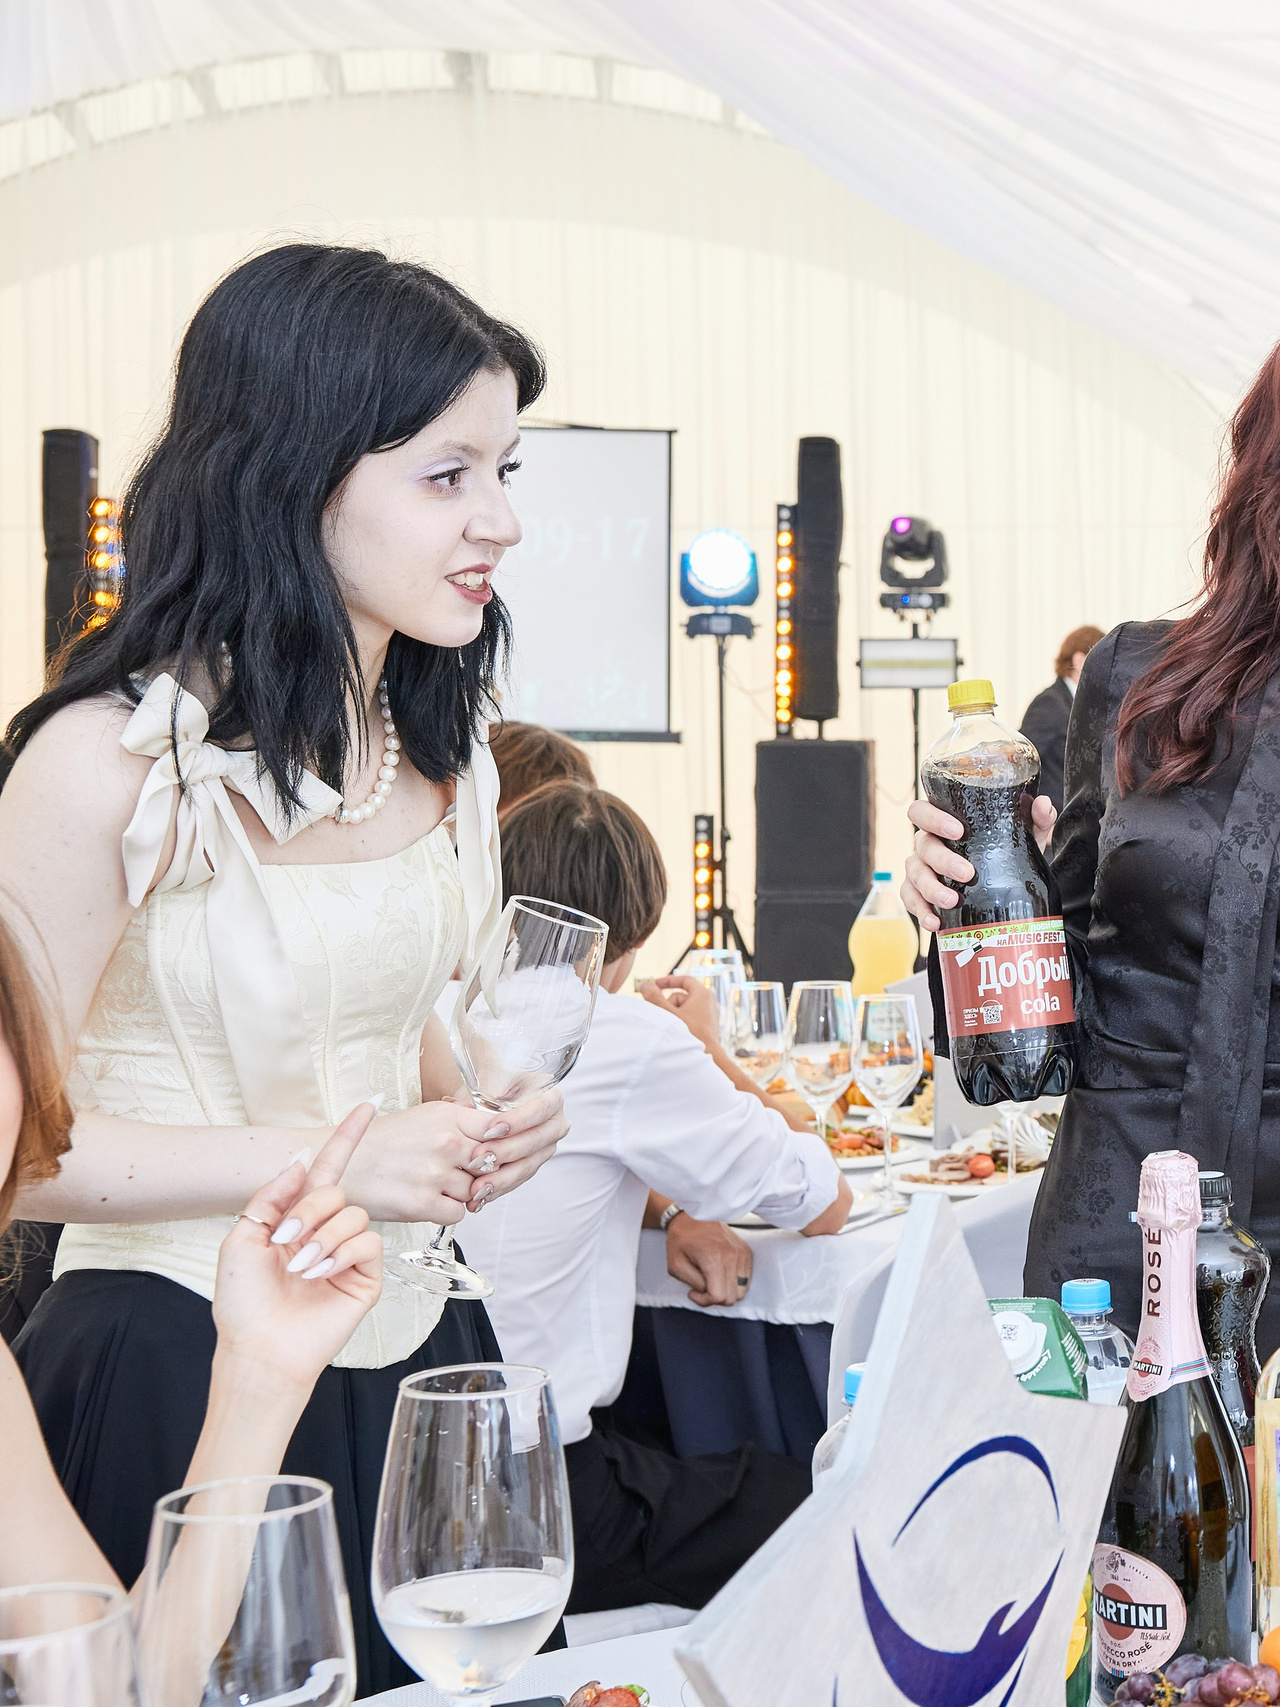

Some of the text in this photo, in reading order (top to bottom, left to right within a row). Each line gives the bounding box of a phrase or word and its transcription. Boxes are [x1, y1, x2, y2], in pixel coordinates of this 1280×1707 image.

[1008, 932, 1043, 946] MUSIC
[1043, 931, 1061, 943] FEST
[1020, 992, 1061, 1015] cola
[1144, 1227, 1162, 1318] ROSÉ
[1133, 1361, 1162, 1375] MARTINI
[1094, 1590, 1163, 1628] MARTINI
[1098, 1631, 1152, 1658] OSECCO ROSÉ
